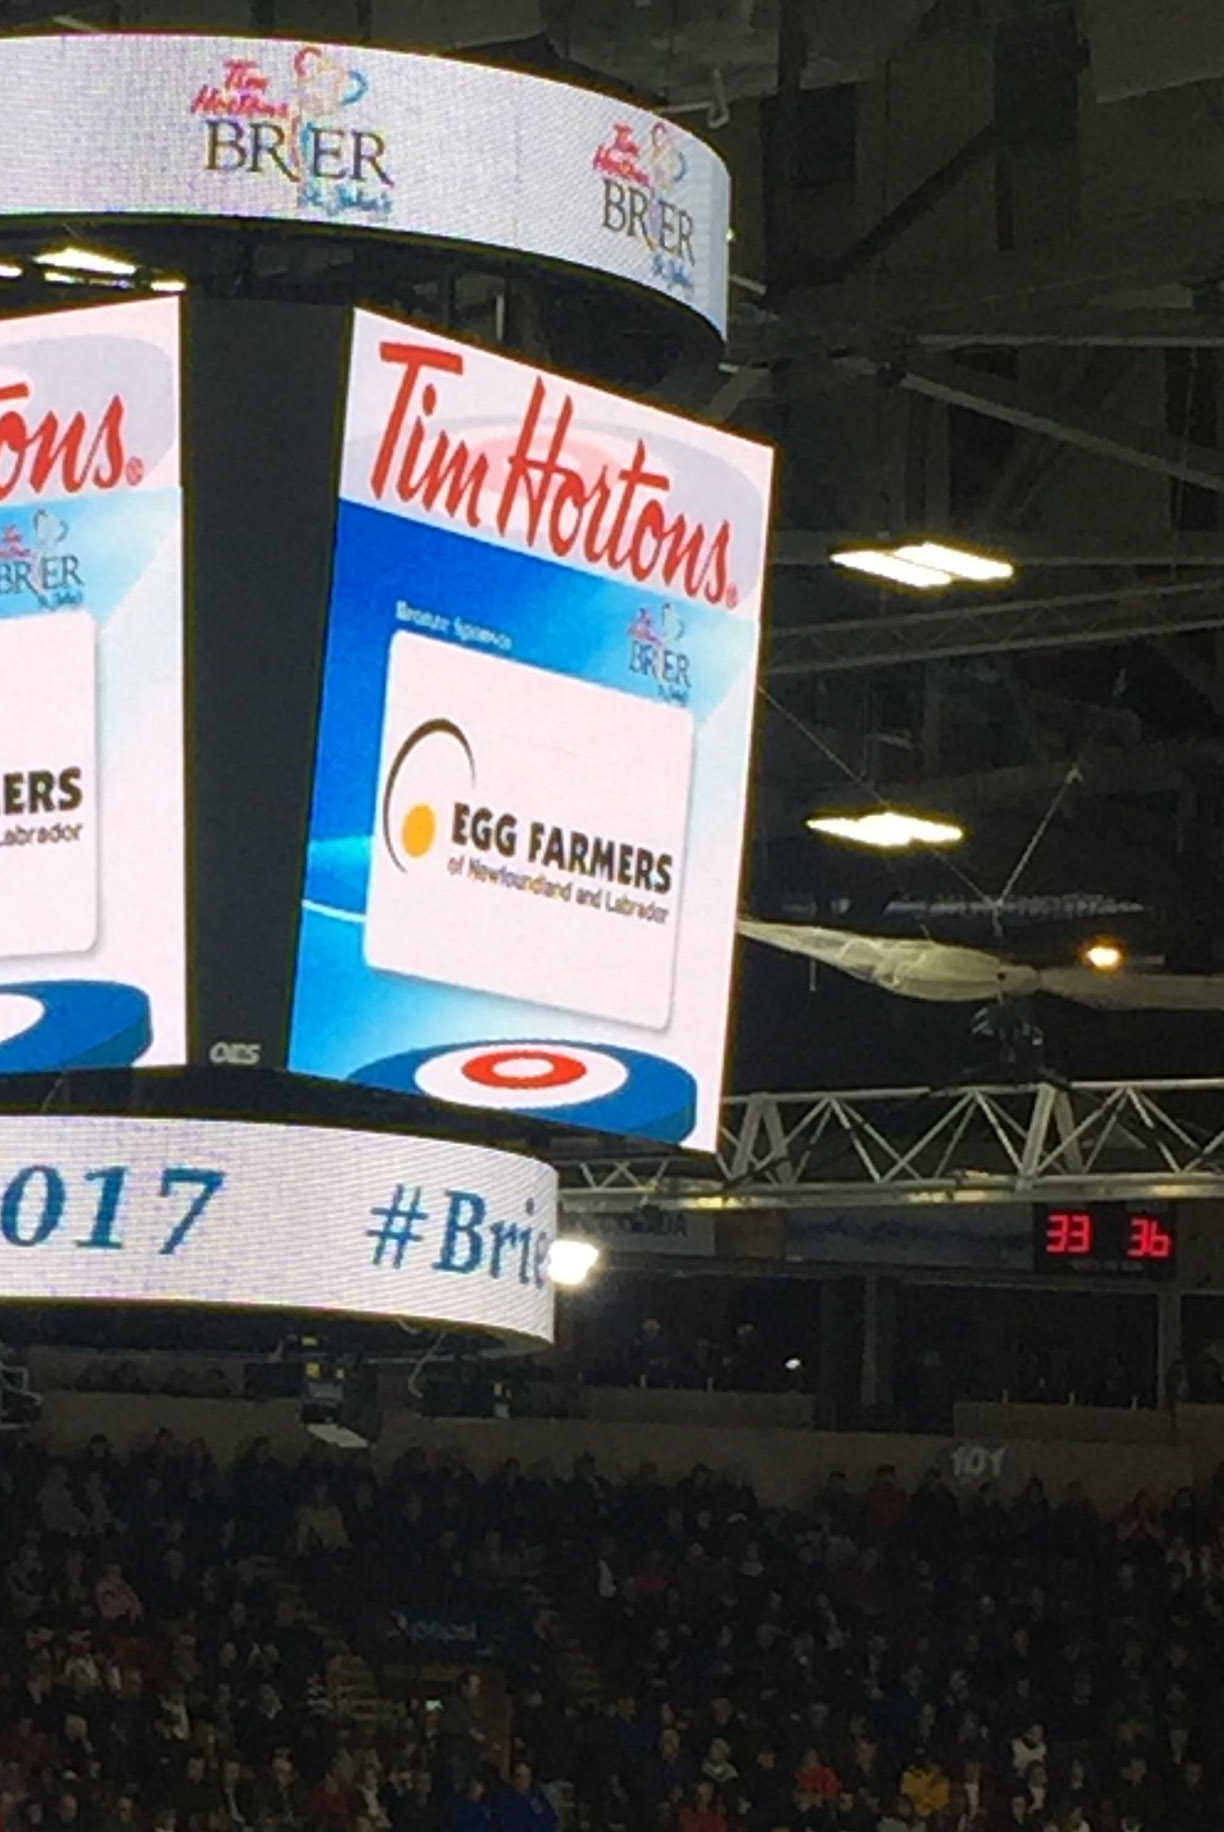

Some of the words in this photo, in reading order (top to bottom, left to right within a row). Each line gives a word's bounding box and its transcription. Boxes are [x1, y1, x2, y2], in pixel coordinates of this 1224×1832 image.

[370, 341, 490, 528] Tim
[495, 374, 732, 605] Hortons
[451, 801, 518, 858] EGG
[527, 821, 674, 895] FARMERS
[447, 854, 466, 877] of
[468, 857, 573, 904] Newfoundland
[575, 885, 603, 911] and
[605, 886, 670, 925] Labrador
[1045, 1213, 1091, 1253] 33
